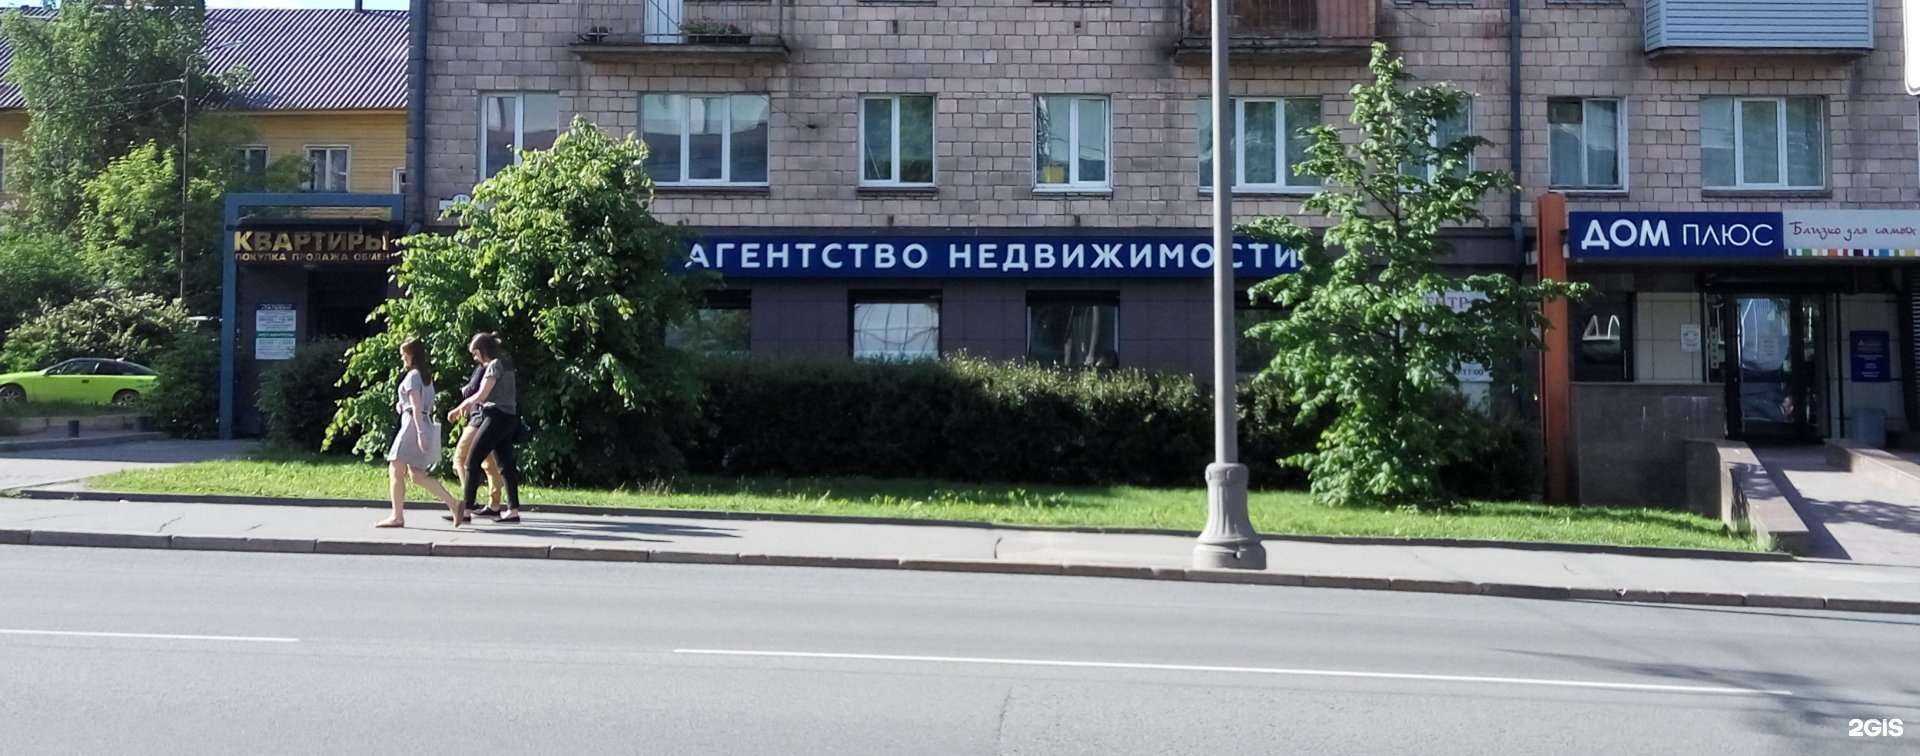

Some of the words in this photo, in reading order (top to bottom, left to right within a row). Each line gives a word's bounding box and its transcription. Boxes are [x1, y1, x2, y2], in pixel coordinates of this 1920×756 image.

[234, 231, 389, 251] КВАРТИРЫ
[1580, 219, 1671, 250] ДОМ
[1682, 223, 1774, 246] ПЛЮС
[1789, 221, 1841, 240] Близко
[1843, 228, 1868, 241] для
[235, 252, 286, 261] ПОКУПКА
[291, 252, 349, 261] ПРОДАЖА
[684, 243, 928, 269] АГЕНТСТВО
